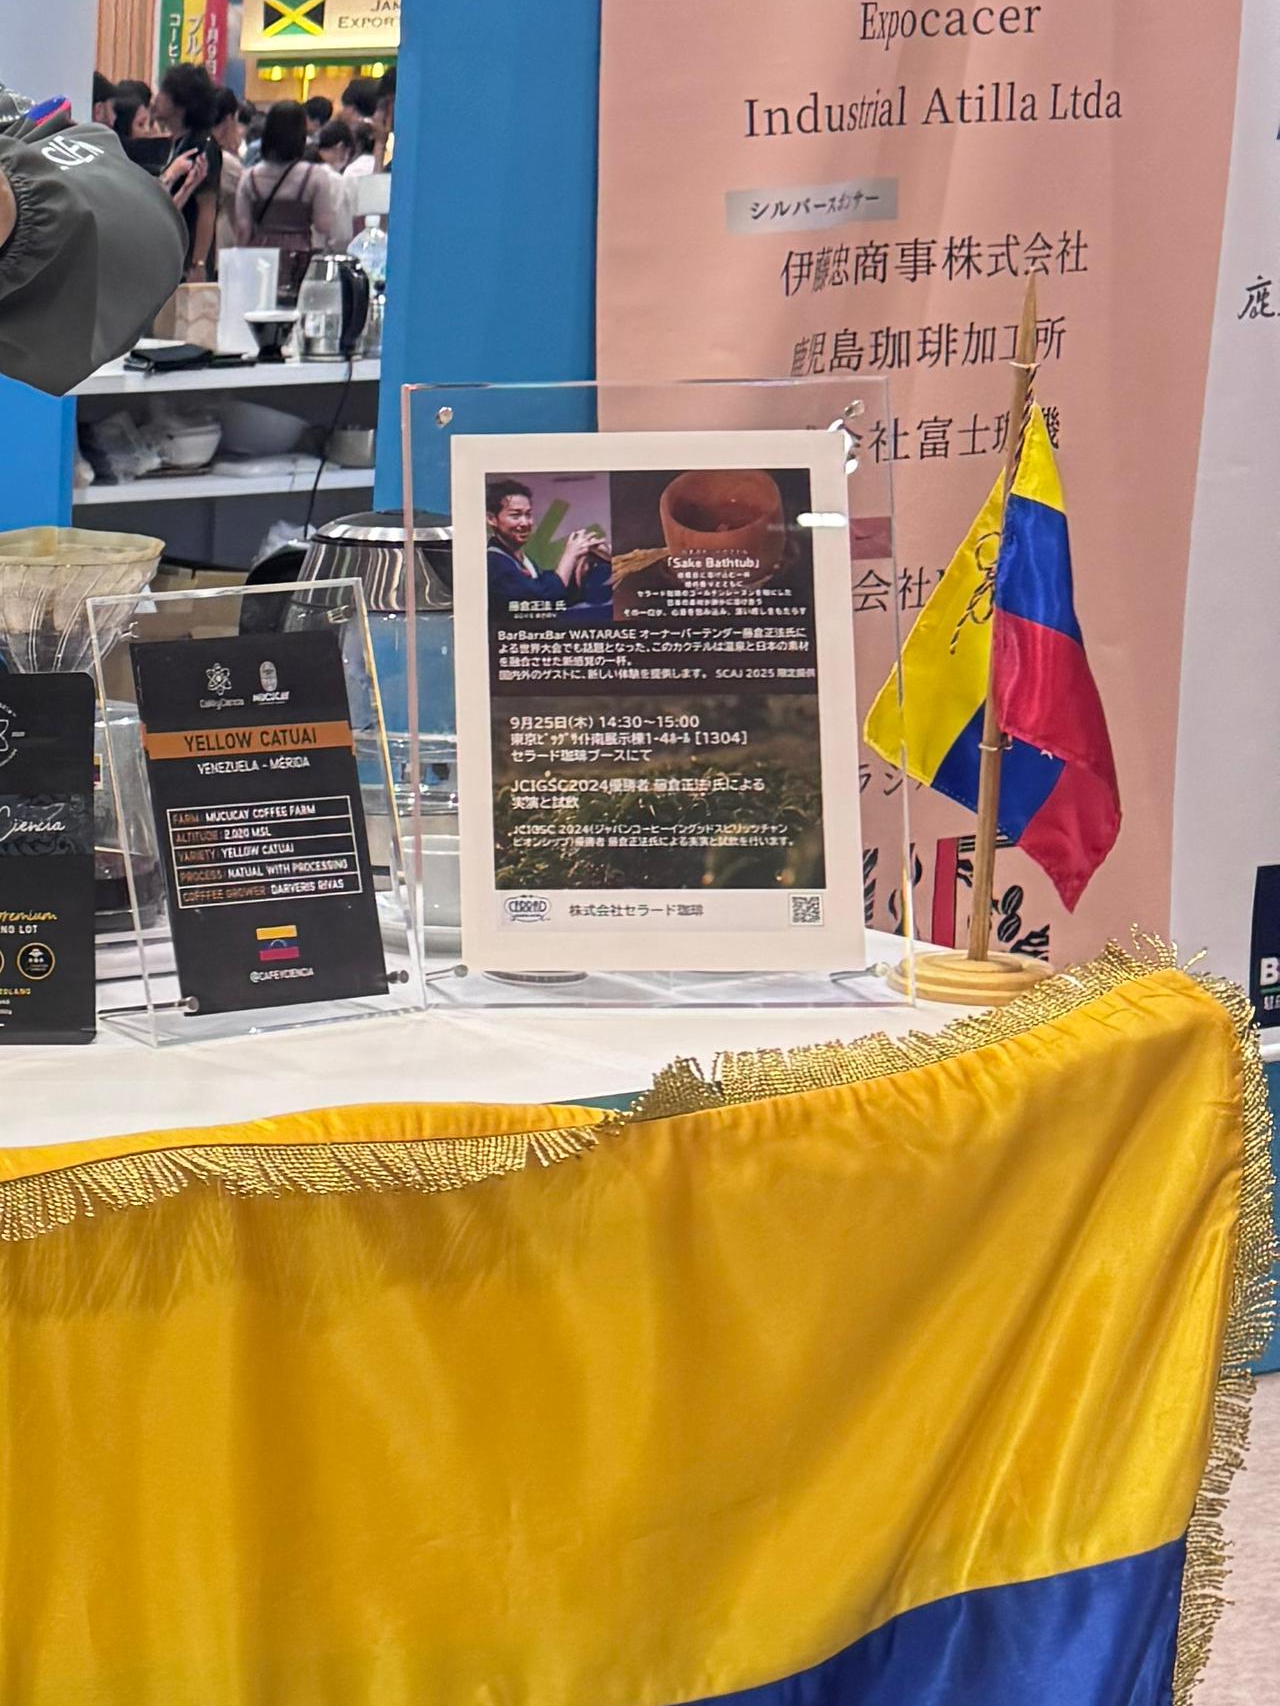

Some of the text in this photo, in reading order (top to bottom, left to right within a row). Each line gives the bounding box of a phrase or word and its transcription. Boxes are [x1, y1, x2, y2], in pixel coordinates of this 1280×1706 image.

[860, 1, 1042, 51] Expocacer
[744, 79, 1122, 137] Industrial Atilla Ltda
[780, 230, 1089, 297] 伊藤忠商事株式会社
[569, 629, 637, 639] WATARASE
[746, 668, 775, 678] 2025
[510, 716, 594, 730] 9月25日(木)
[184, 727, 317, 752] YELLOW CATUAI
[19, 924, 38, 934] LOT
